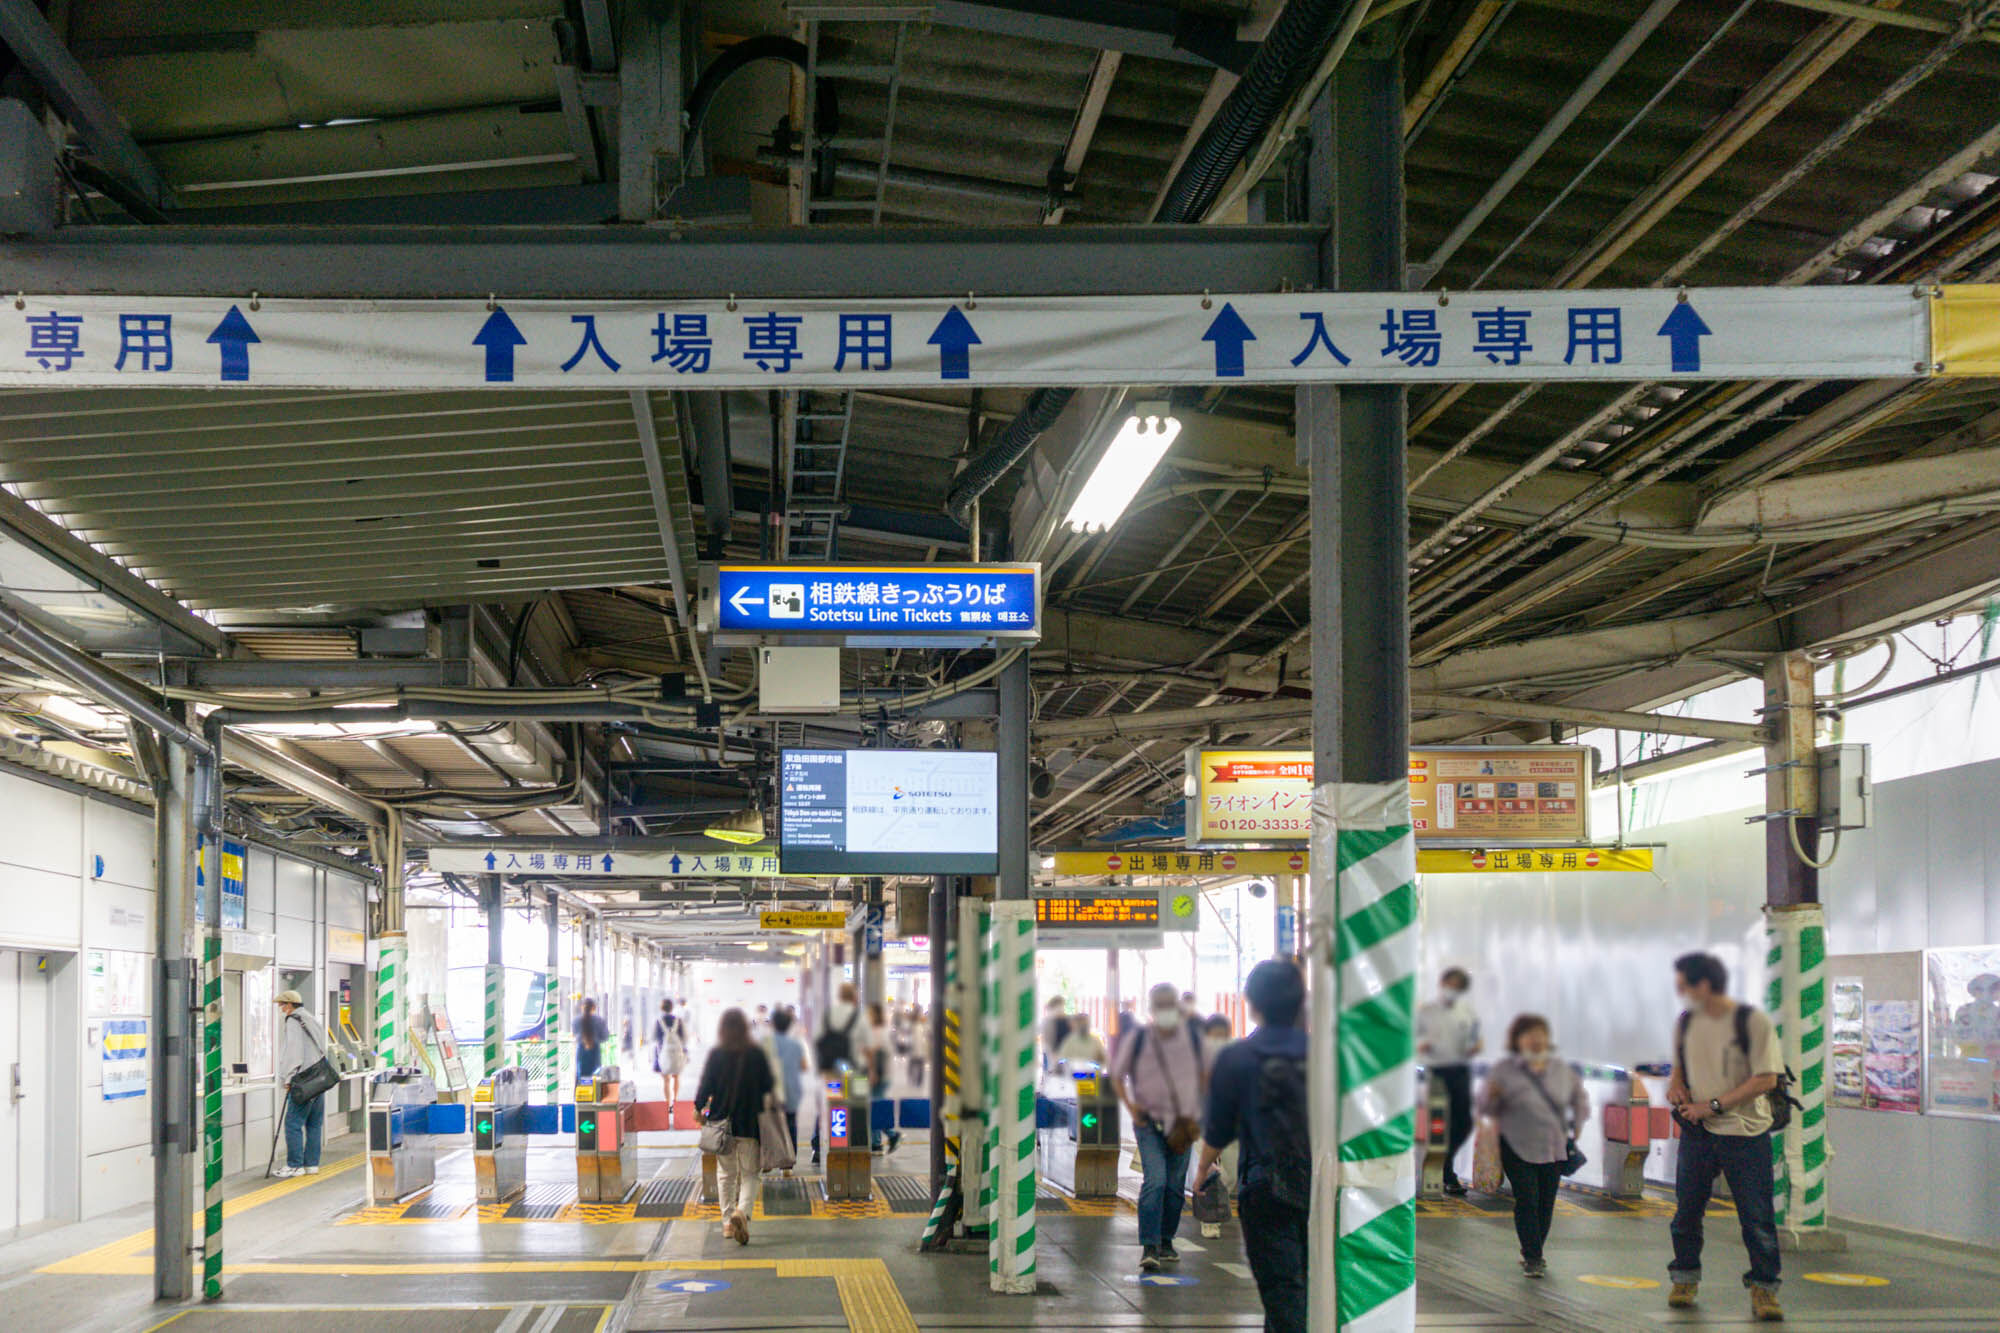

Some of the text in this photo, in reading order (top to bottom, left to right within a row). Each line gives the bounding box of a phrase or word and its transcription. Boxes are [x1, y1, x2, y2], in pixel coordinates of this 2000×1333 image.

[24, 310, 175, 373] 専用
[561, 310, 893, 375] 入場専用
[1290, 305, 1623, 368] 入場専用
[809, 582, 1006, 605] 相鉄線きっぷうりば
[809, 608, 952, 622] Sotetsu Line Tickets
[506, 852, 594, 871] 入場専用
[691, 854, 778, 873] 入場専用
[1129, 854, 1215, 872] 出場専用
[1493, 852, 1578, 870] 出場専用
[832, 1110, 846, 1123] IC
